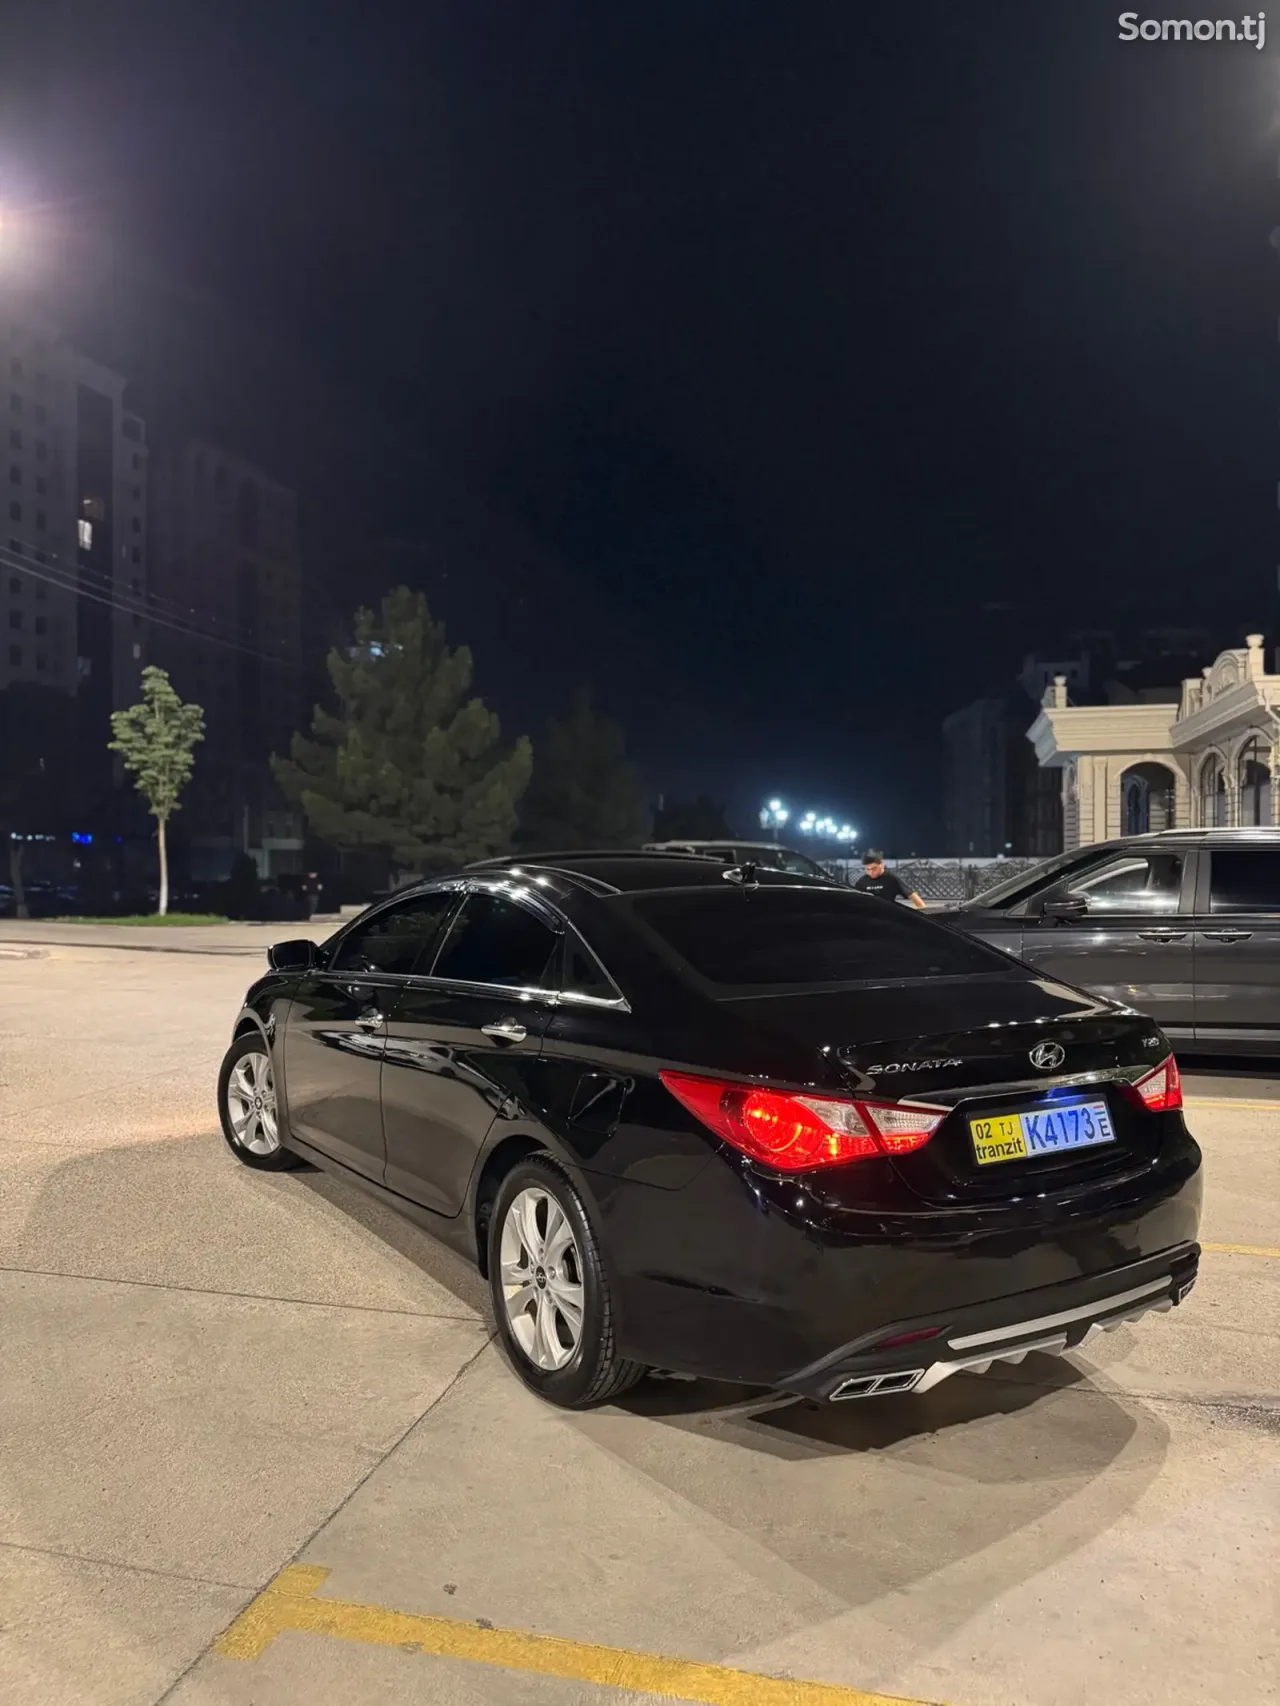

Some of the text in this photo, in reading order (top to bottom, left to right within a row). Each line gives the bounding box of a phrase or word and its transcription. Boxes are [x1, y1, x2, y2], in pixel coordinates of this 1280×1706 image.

[865, 1058, 964, 1075] SONATA
[975, 1121, 1014, 1140] 02 TJ
[1024, 1107, 1096, 1151] K4173
[975, 1137, 1024, 1160] tranzit
